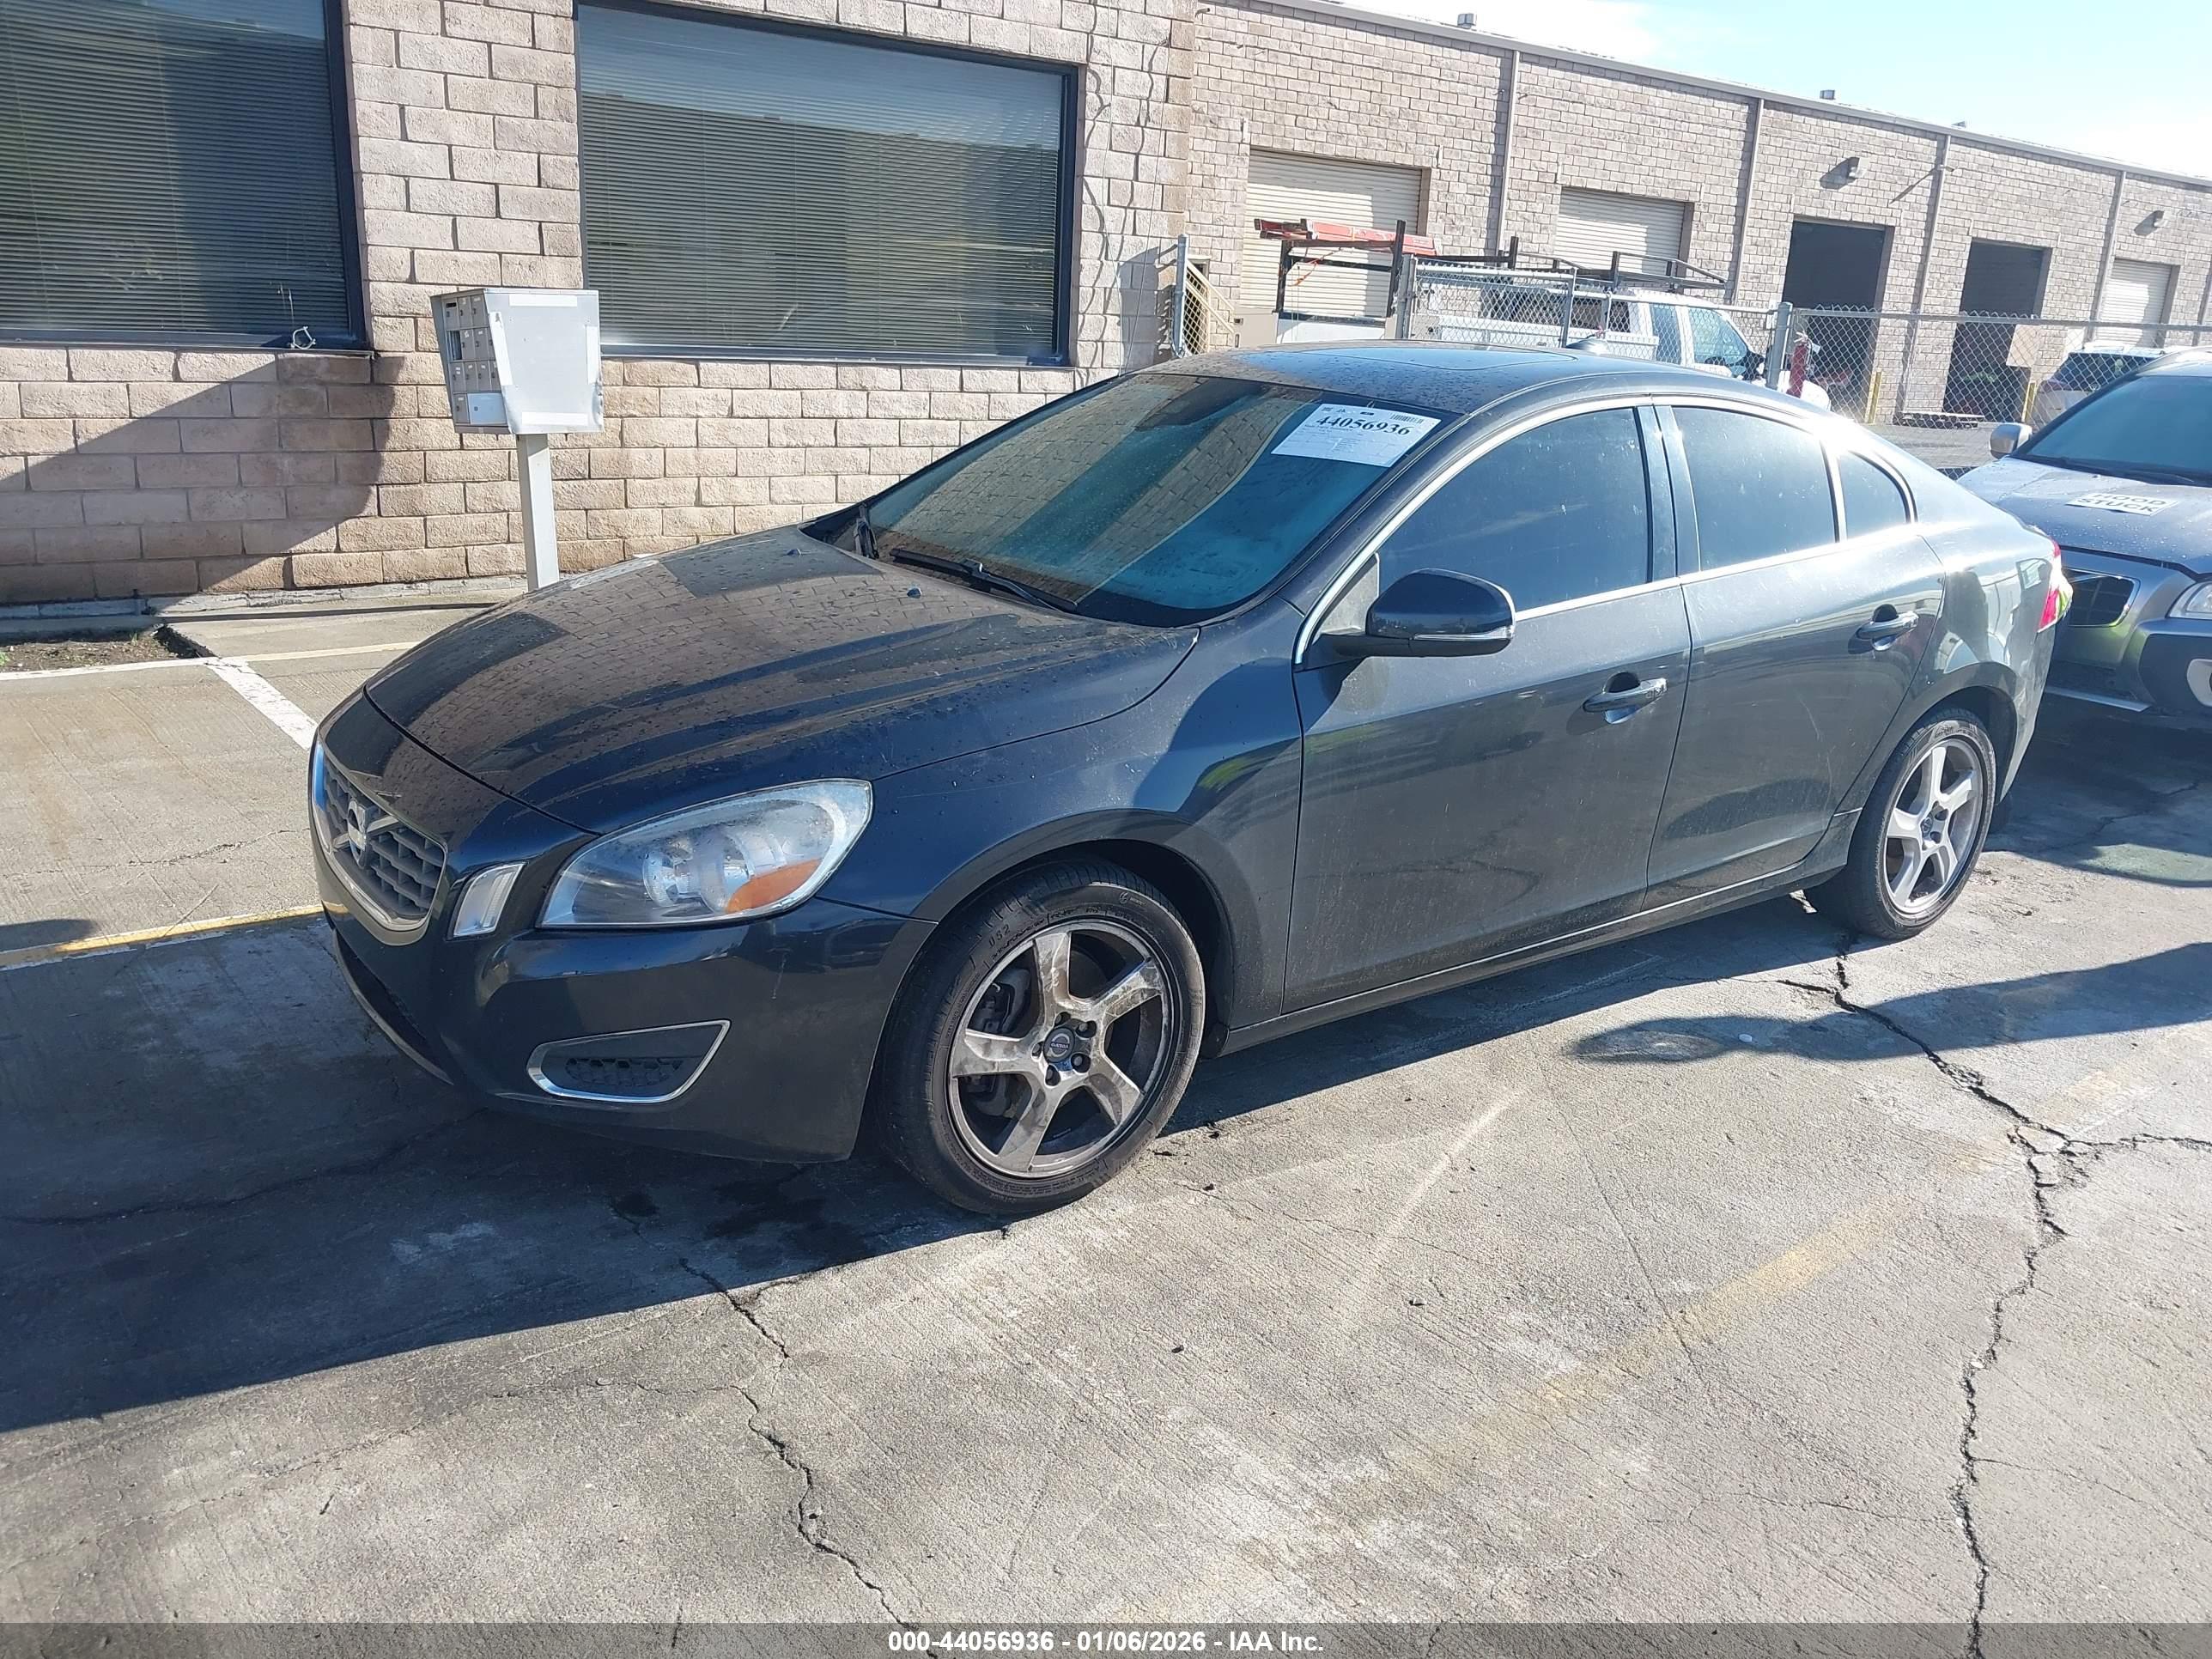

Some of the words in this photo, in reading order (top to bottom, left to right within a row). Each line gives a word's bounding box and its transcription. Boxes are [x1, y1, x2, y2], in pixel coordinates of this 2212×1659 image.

[1316, 416, 1415, 435] 44056936
[2077, 498, 2158, 512] STUCK
[2094, 494, 2166, 505] HOOD
